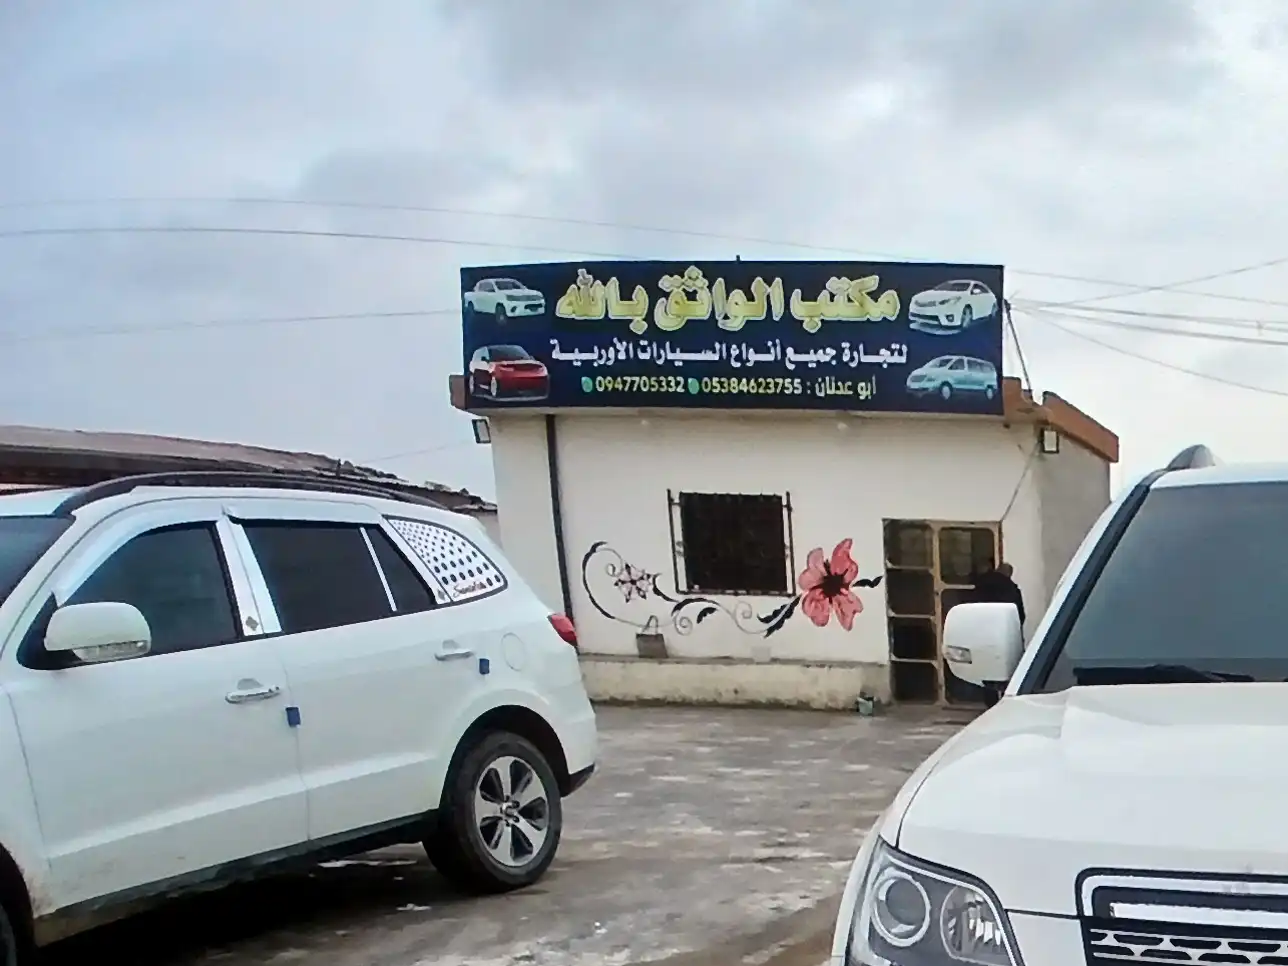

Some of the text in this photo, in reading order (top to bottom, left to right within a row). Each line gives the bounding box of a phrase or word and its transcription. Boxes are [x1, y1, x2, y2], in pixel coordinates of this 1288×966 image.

[555, 265, 900, 334] مكتب الواثق بالله
[637, 339, 727, 366] السيارات
[785, 346, 836, 370] جميع
[841, 342, 907, 368] لتجارة
[595, 376, 685, 393] 0947705332
[702, 377, 802, 394] 05384623755
